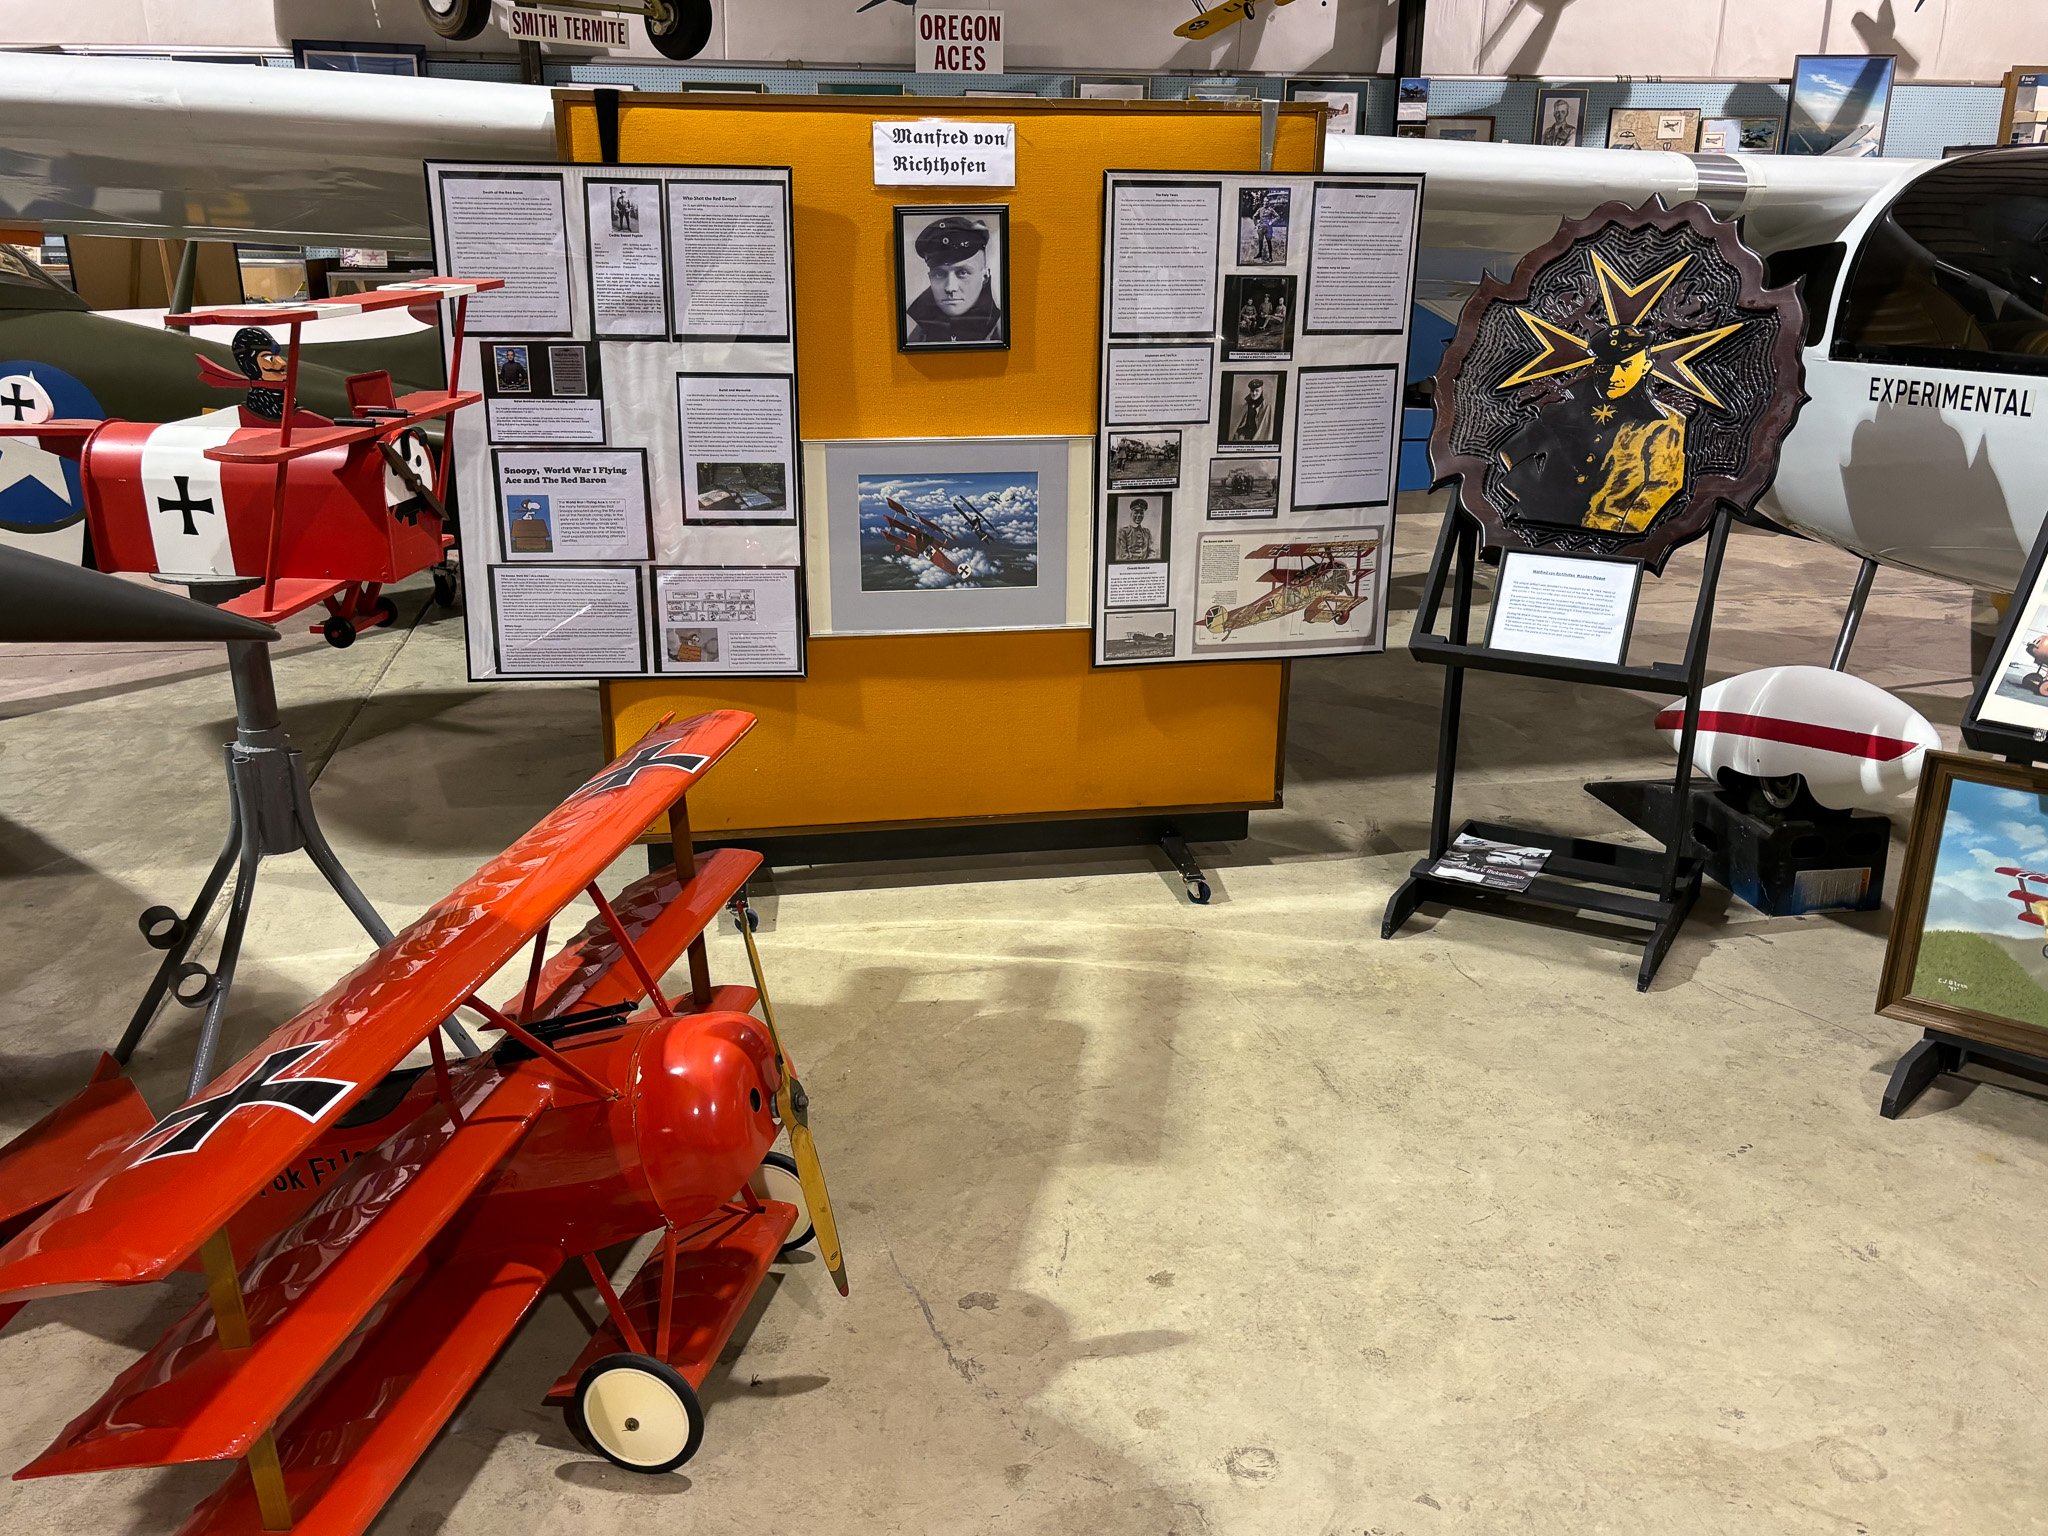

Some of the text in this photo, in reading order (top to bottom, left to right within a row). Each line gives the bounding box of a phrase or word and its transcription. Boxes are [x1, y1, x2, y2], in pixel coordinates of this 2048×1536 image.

[512, 11, 625, 44] SMITH TERMITE
[920, 14, 1000, 41] OREGON
[934, 45, 986, 71] ACES
[892, 128, 1005, 147] Manfred von
[893, 156, 986, 175] Richthofen
[1869, 377, 2032, 417] EXPERIMENTAL
[504, 467, 540, 475] Snoopy,
[599, 467, 627, 475] Flying
